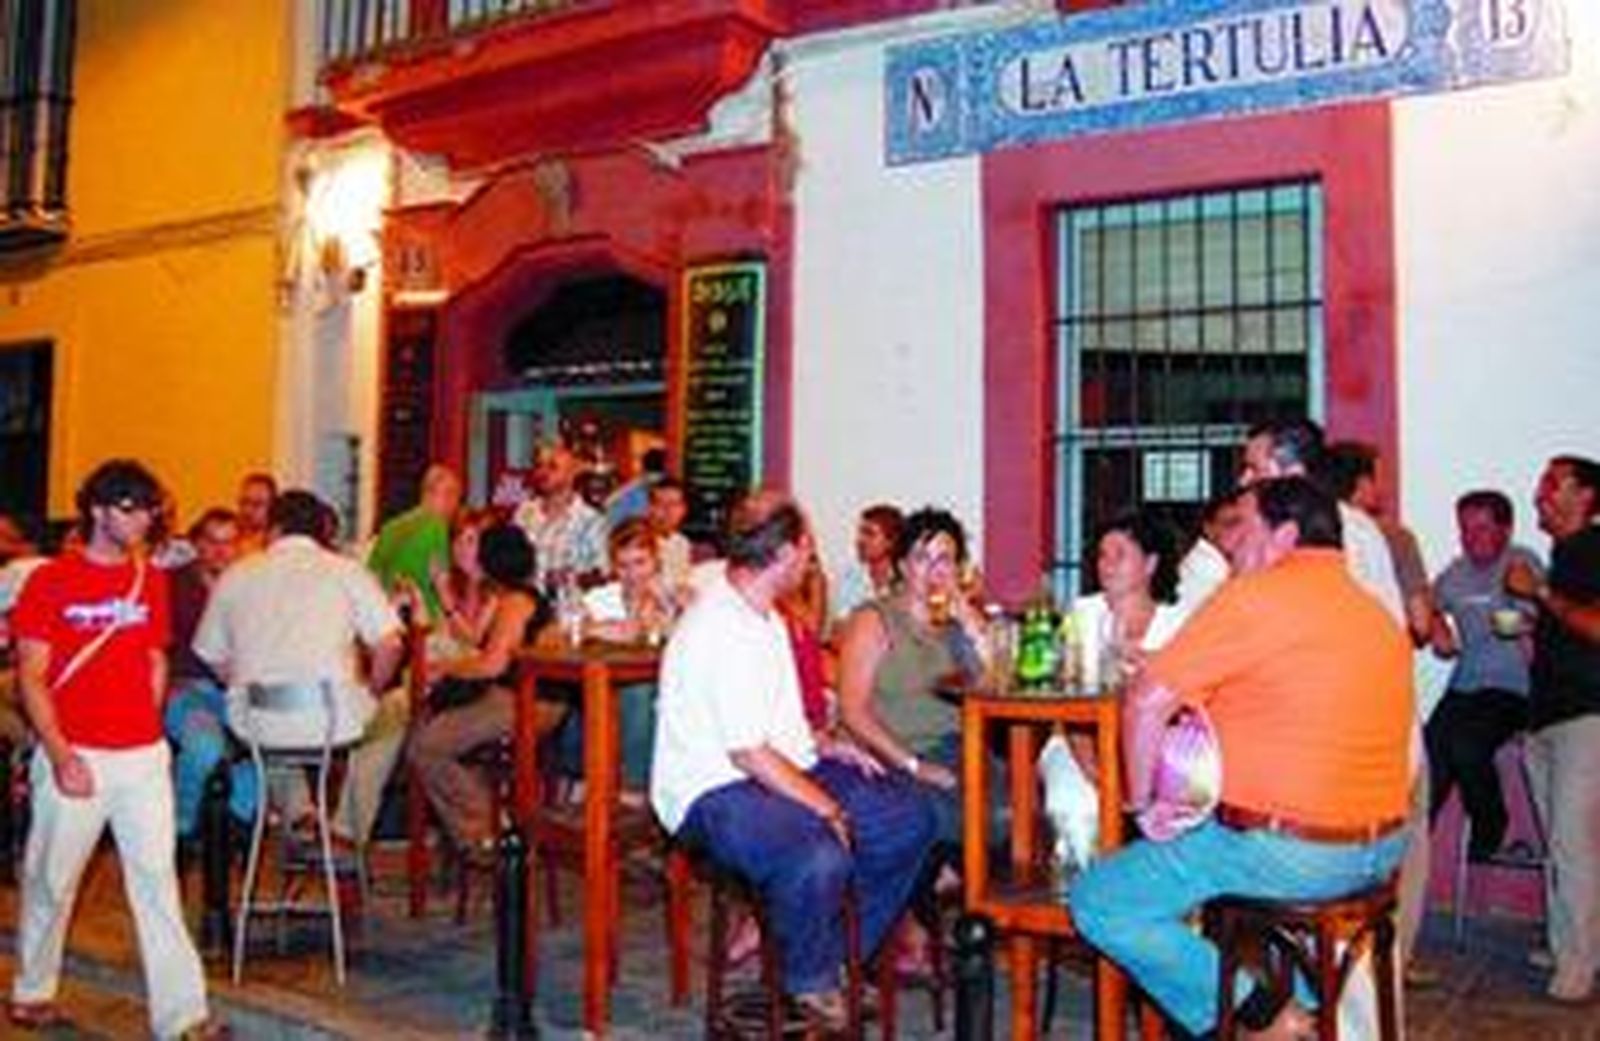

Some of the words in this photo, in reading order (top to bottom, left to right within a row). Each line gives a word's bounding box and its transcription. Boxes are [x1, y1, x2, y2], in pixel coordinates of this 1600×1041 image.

[1020, 54, 1084, 111] LA
[1107, 4, 1389, 97] TERTULIA
[1489, 0, 1526, 41] 13
